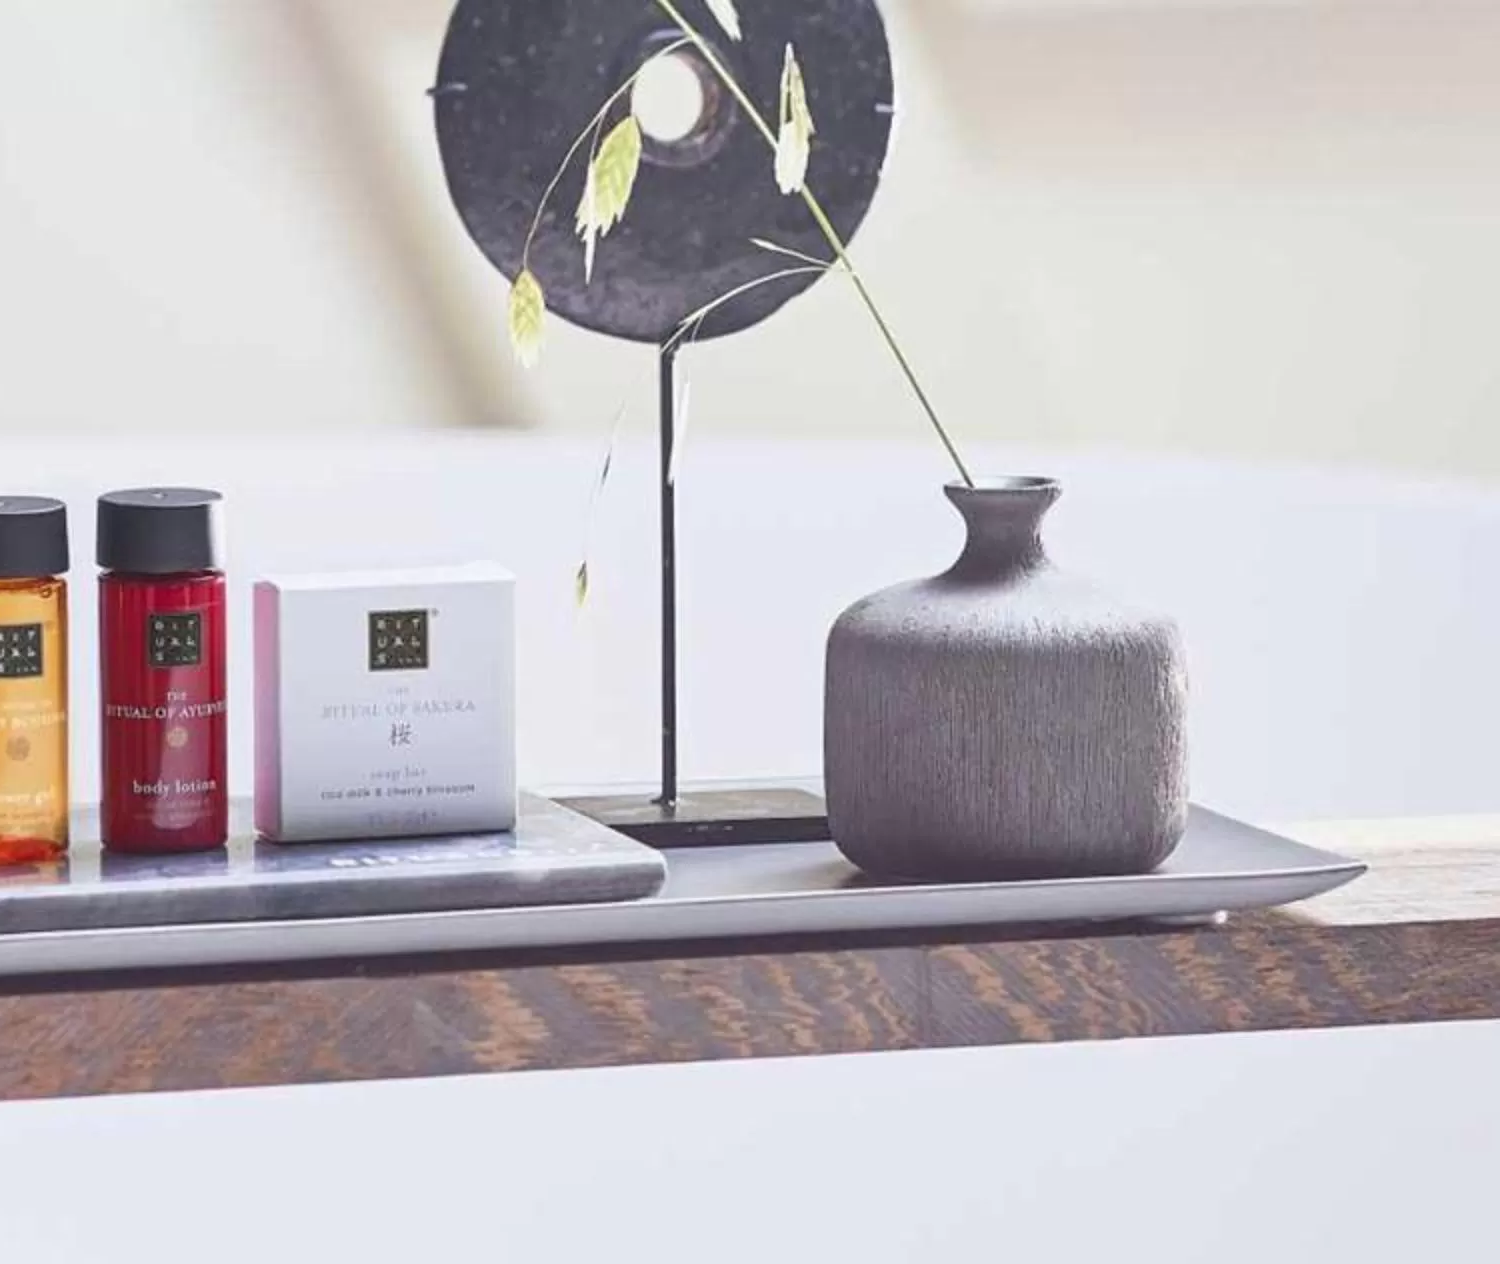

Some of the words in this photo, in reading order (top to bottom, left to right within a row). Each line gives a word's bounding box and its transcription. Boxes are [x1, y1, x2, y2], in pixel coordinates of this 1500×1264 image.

[155, 704, 176, 719] OF
[133, 780, 170, 796] body
[175, 778, 217, 793] lotion
